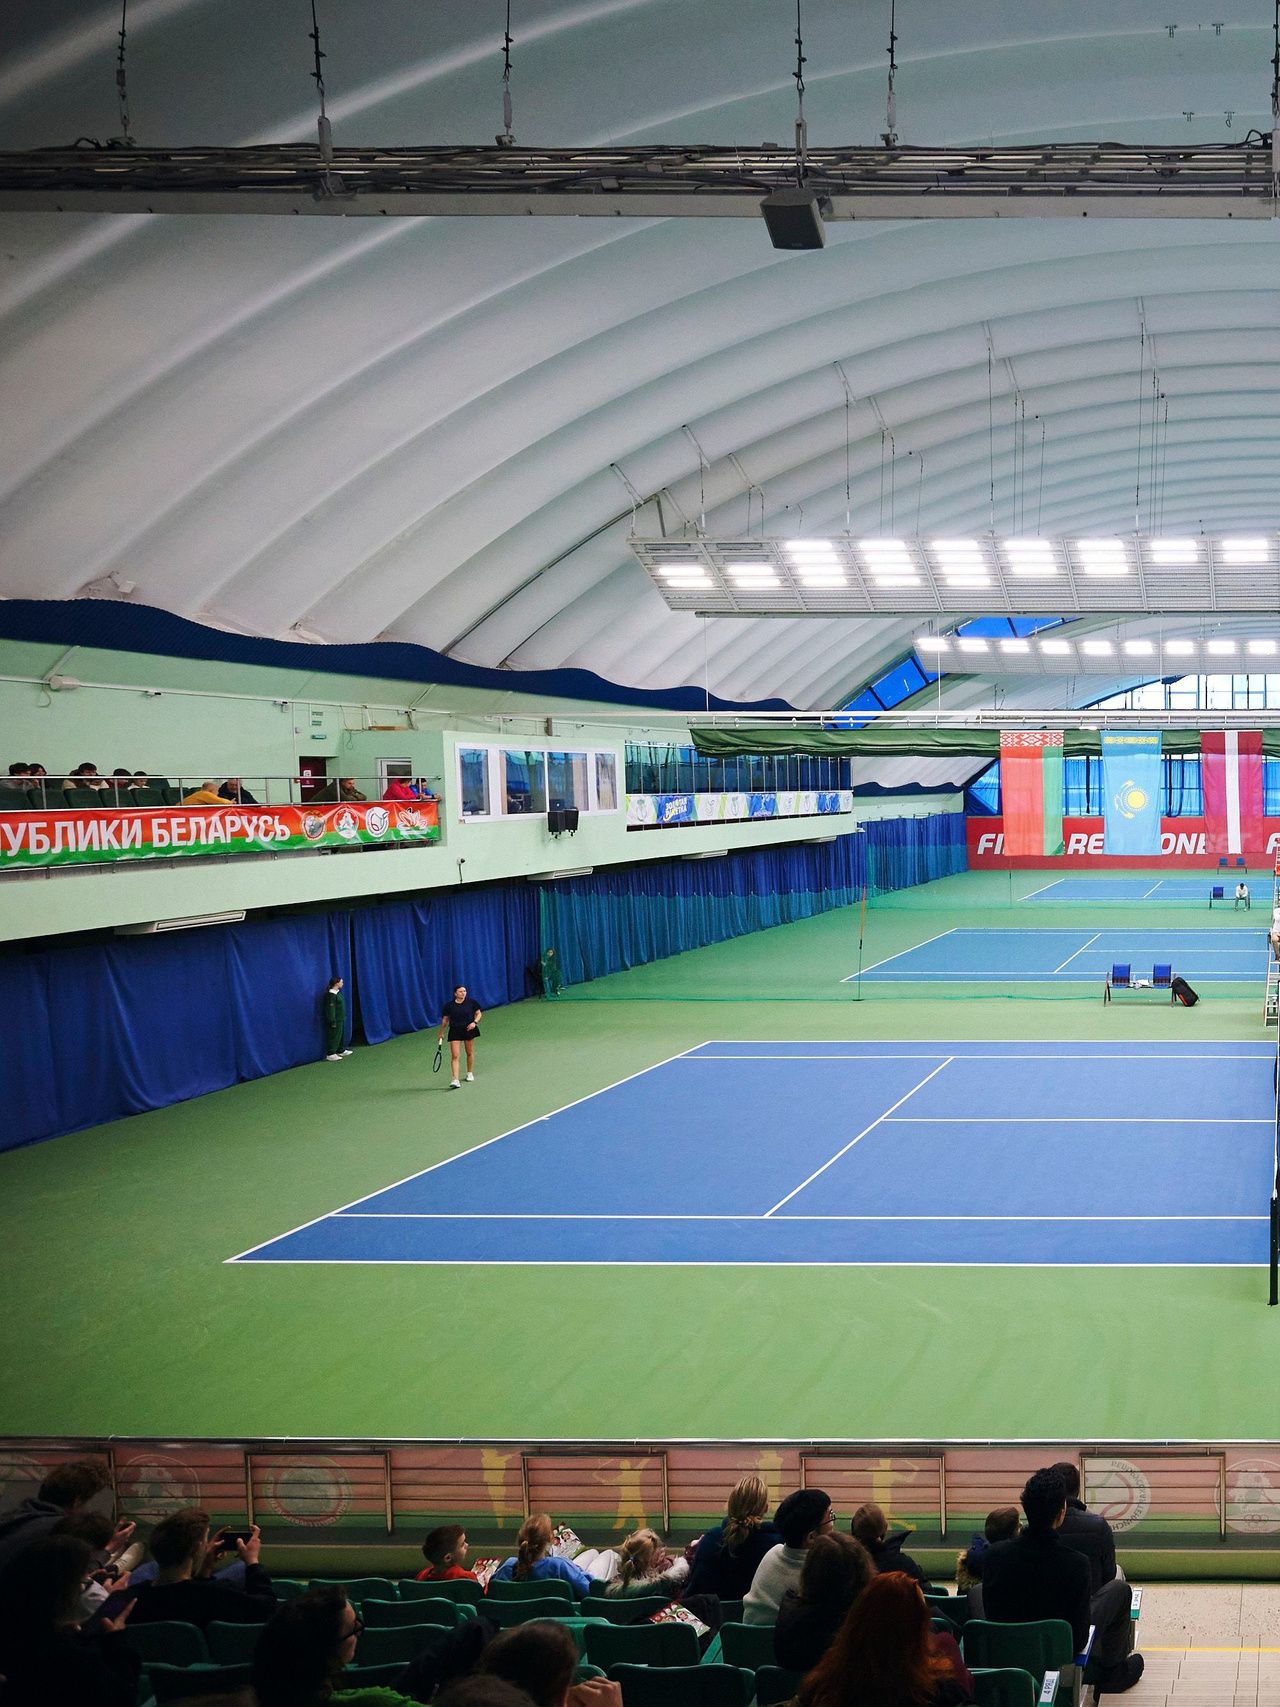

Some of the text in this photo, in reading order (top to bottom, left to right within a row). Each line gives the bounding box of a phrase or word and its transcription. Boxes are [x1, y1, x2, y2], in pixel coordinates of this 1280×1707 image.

[0, 818, 142, 858] УБЛИКИ
[151, 815, 291, 848] БЕЛАРУСЬ
[1067, 833, 1104, 855] RE
